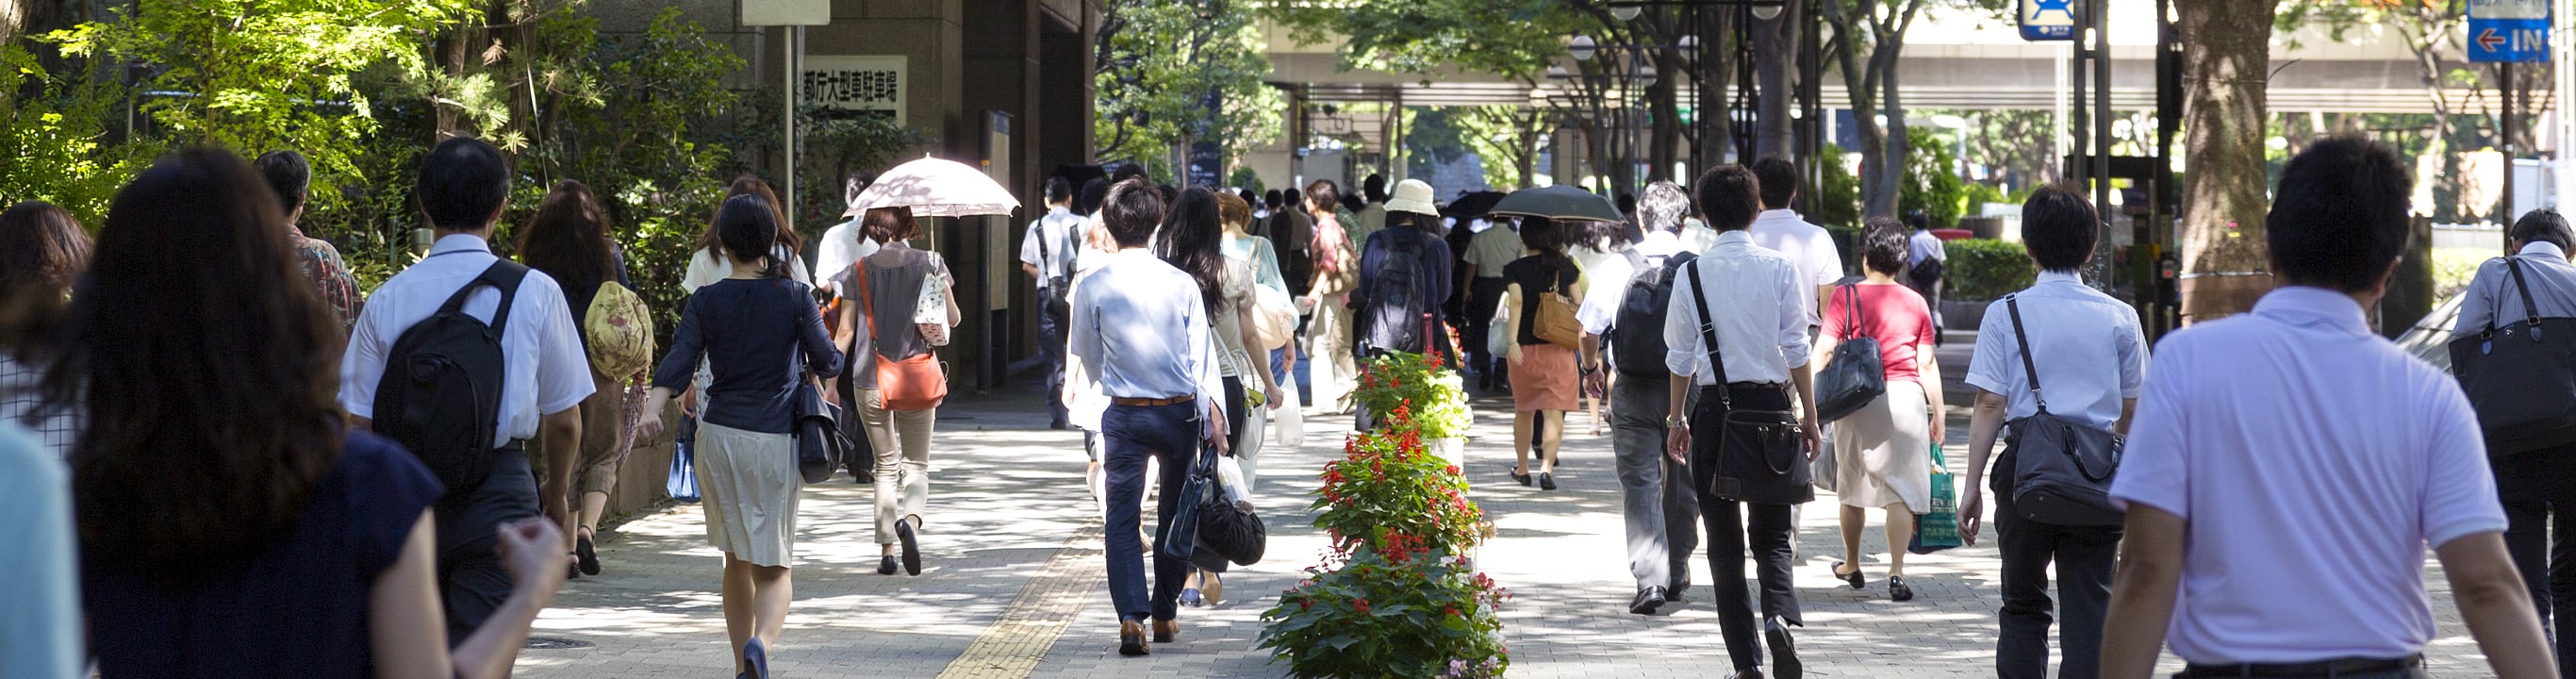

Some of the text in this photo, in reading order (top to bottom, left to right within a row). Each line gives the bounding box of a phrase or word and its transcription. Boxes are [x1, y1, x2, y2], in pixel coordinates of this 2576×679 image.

[2512, 28, 2542, 52] IN
[803, 70, 897, 103] 都庁大型車駐車場
